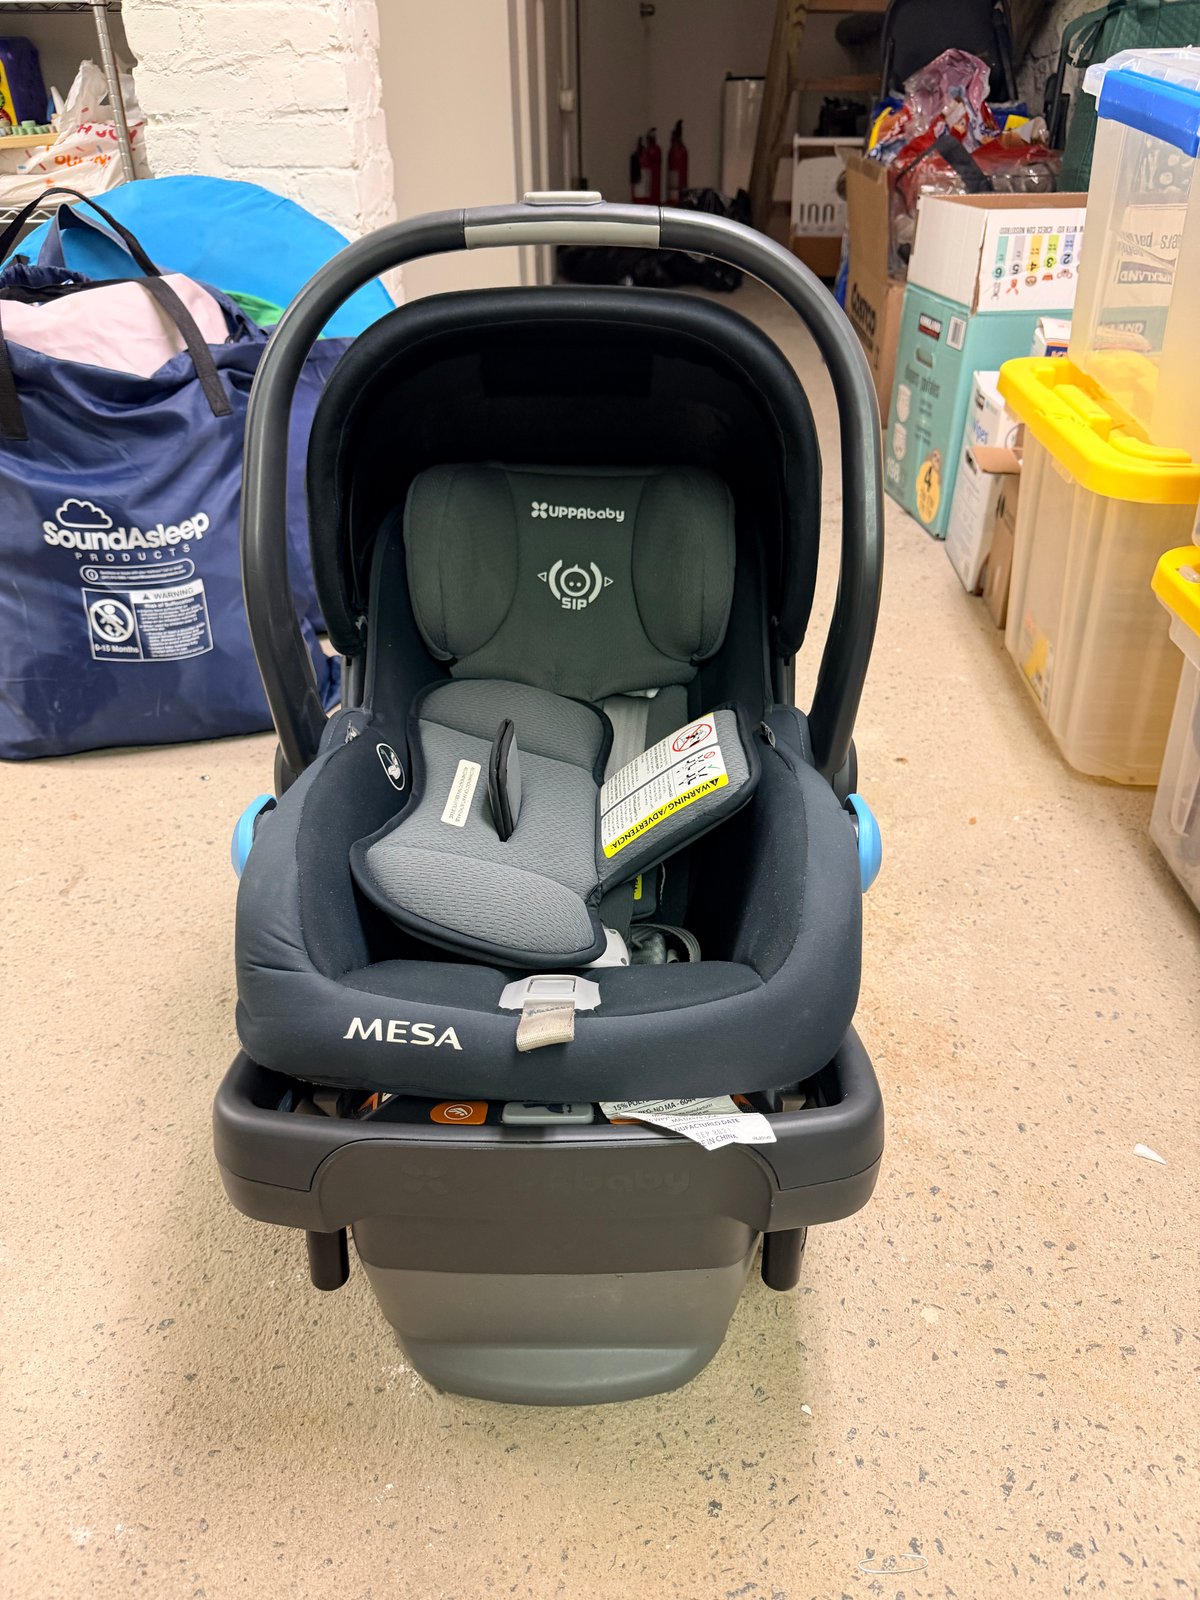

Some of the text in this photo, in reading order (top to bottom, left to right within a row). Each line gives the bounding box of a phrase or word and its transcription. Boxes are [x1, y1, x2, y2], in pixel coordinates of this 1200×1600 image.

[1046, 257, 1054, 268] 3
[1063, 253, 1071, 265] 2
[995, 267, 1003, 279] 6
[1012, 264, 1020, 275] 5
[1030, 262, 1037, 272] 4
[548, 505, 625, 522] UPPAbaby
[43, 512, 209, 551] SoundAsleep
[75, 543, 191, 562] PRODUCTS
[153, 588, 194, 601] WARNING
[561, 597, 587, 611] SIP
[343, 1017, 463, 1050] MESA
[613, 1103, 628, 1111] 15%
[665, 1102, 676, 1110] MA
[715, 1134, 738, 1142] CHINA
